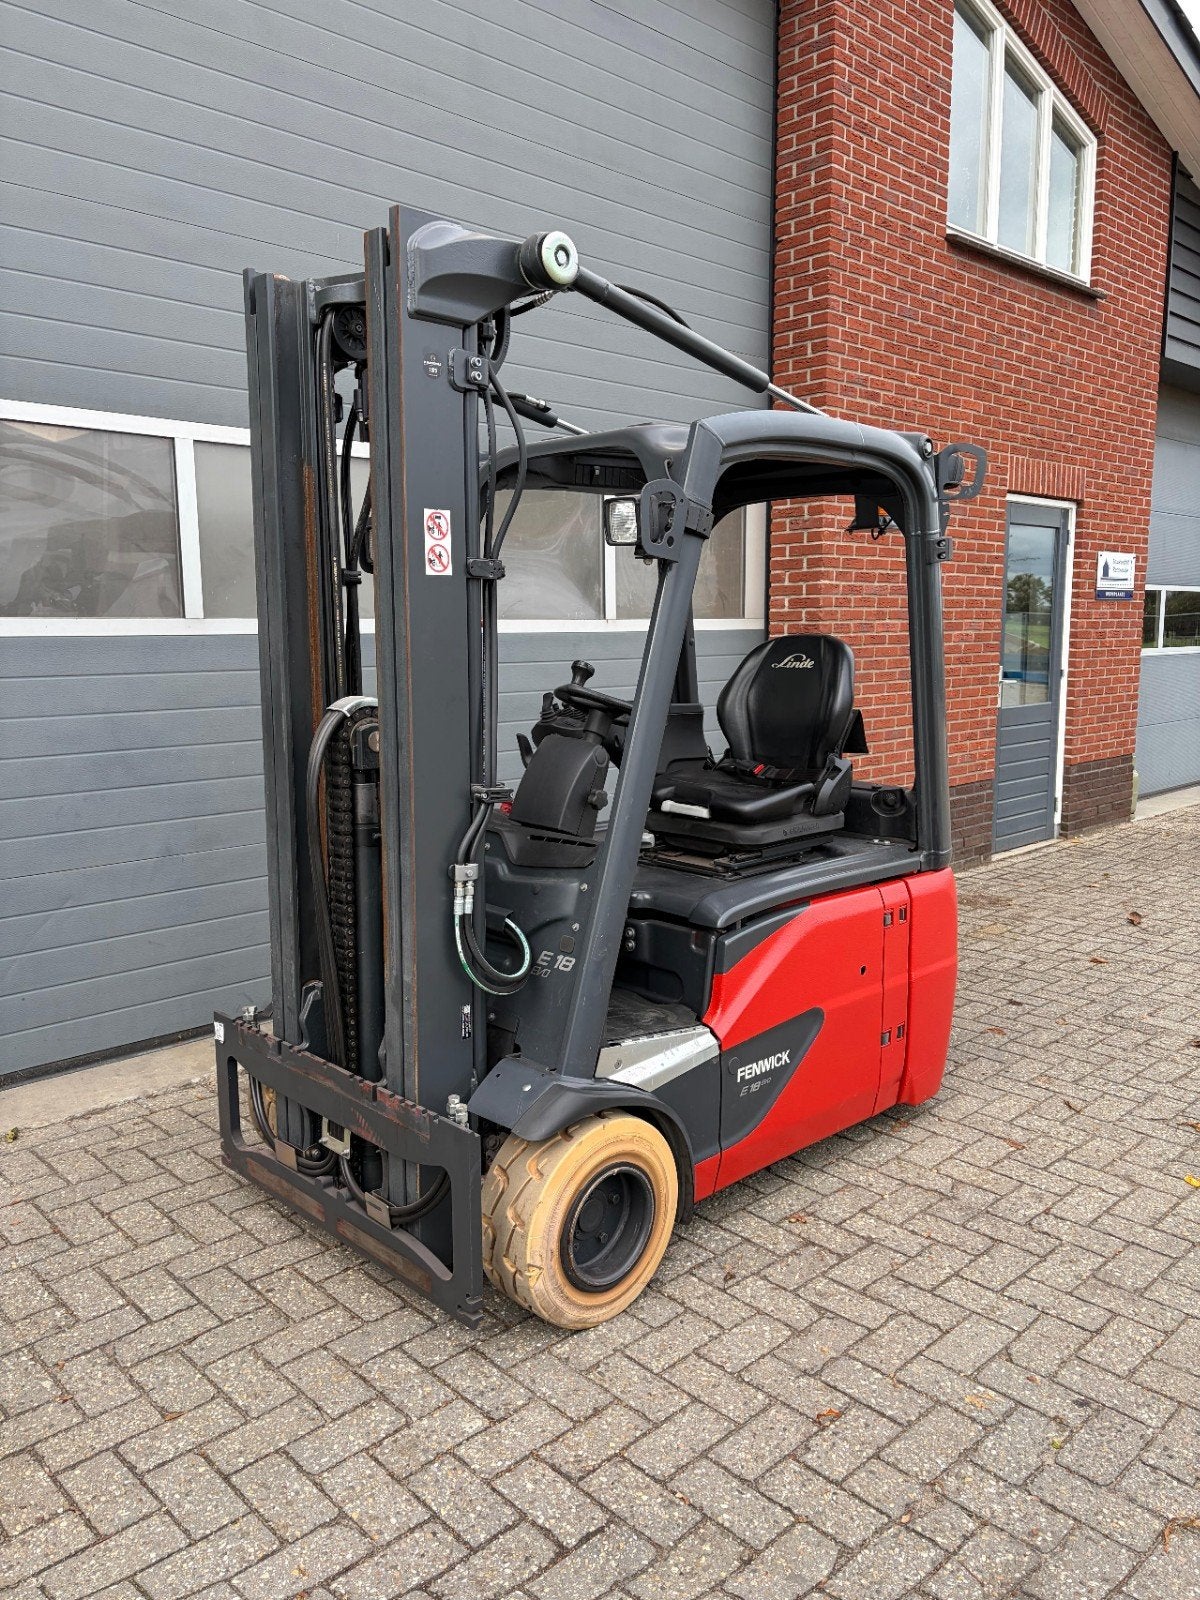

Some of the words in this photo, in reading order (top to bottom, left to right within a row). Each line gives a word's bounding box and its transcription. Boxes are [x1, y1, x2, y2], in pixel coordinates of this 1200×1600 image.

[771, 653, 815, 669] Linde
[537, 950, 554, 966] E
[554, 954, 576, 972] 18
[737, 1049, 790, 1082] FENWICK
